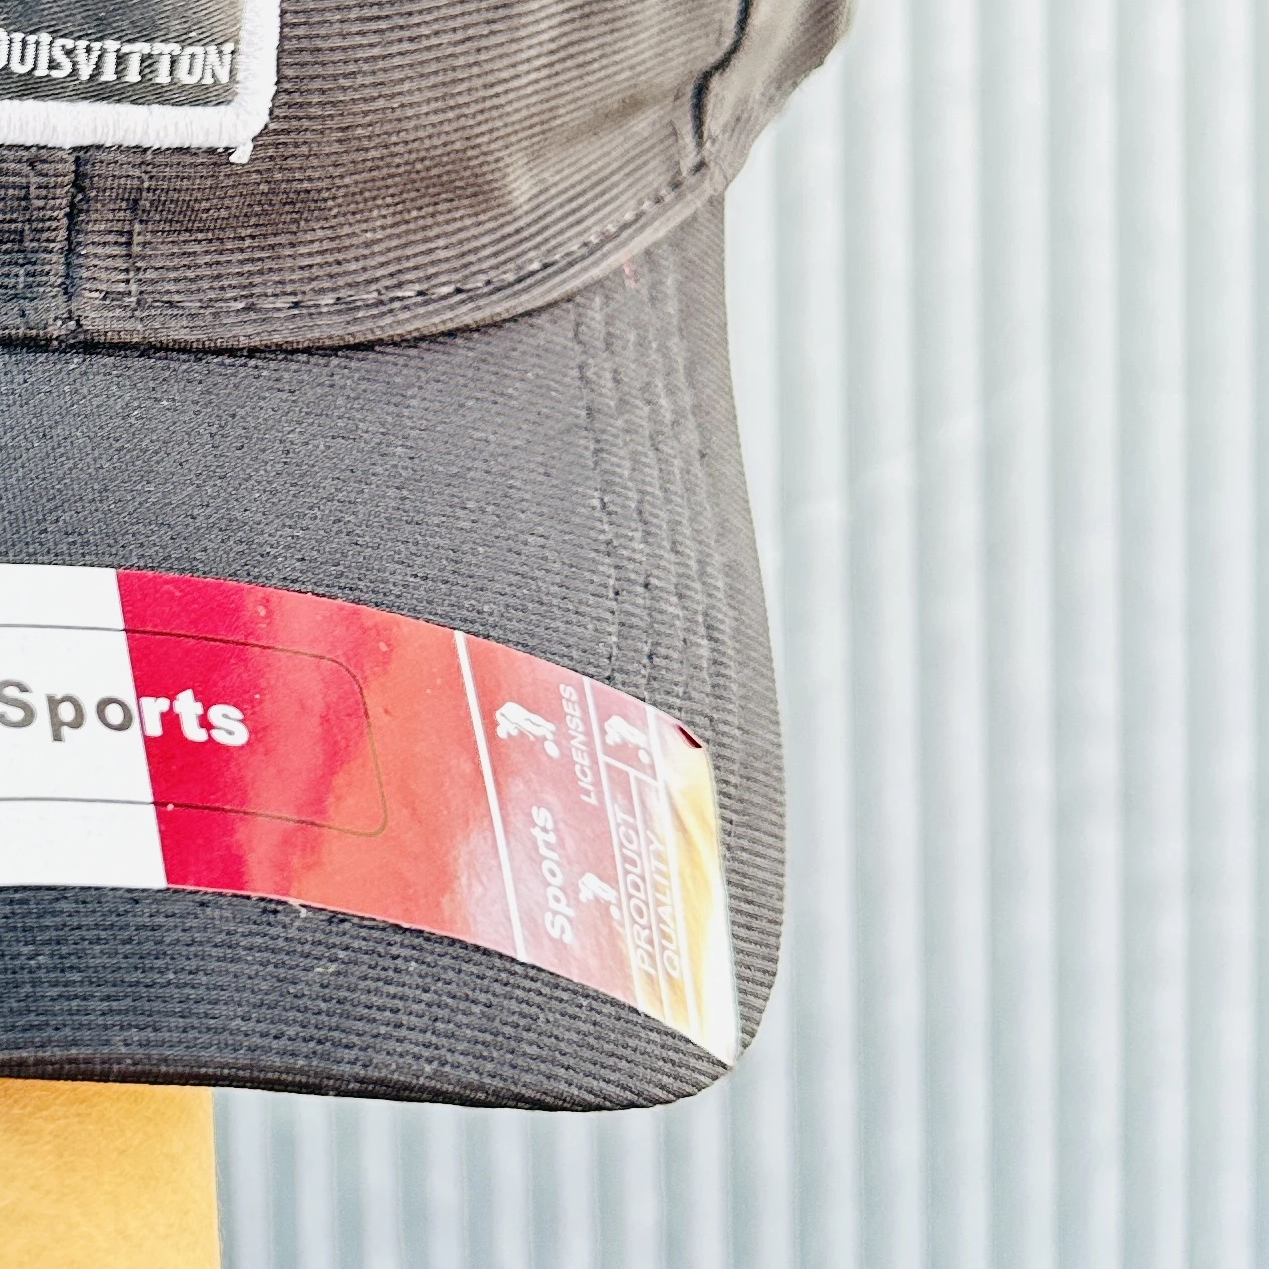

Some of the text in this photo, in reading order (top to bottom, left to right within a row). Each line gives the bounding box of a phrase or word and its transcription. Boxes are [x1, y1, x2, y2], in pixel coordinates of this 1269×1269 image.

[558, 682, 600, 806] LICENSES
[530, 804, 575, 944] Sports
[616, 803, 657, 976] PRODUCT
[648, 830, 684, 976] QUALITY
